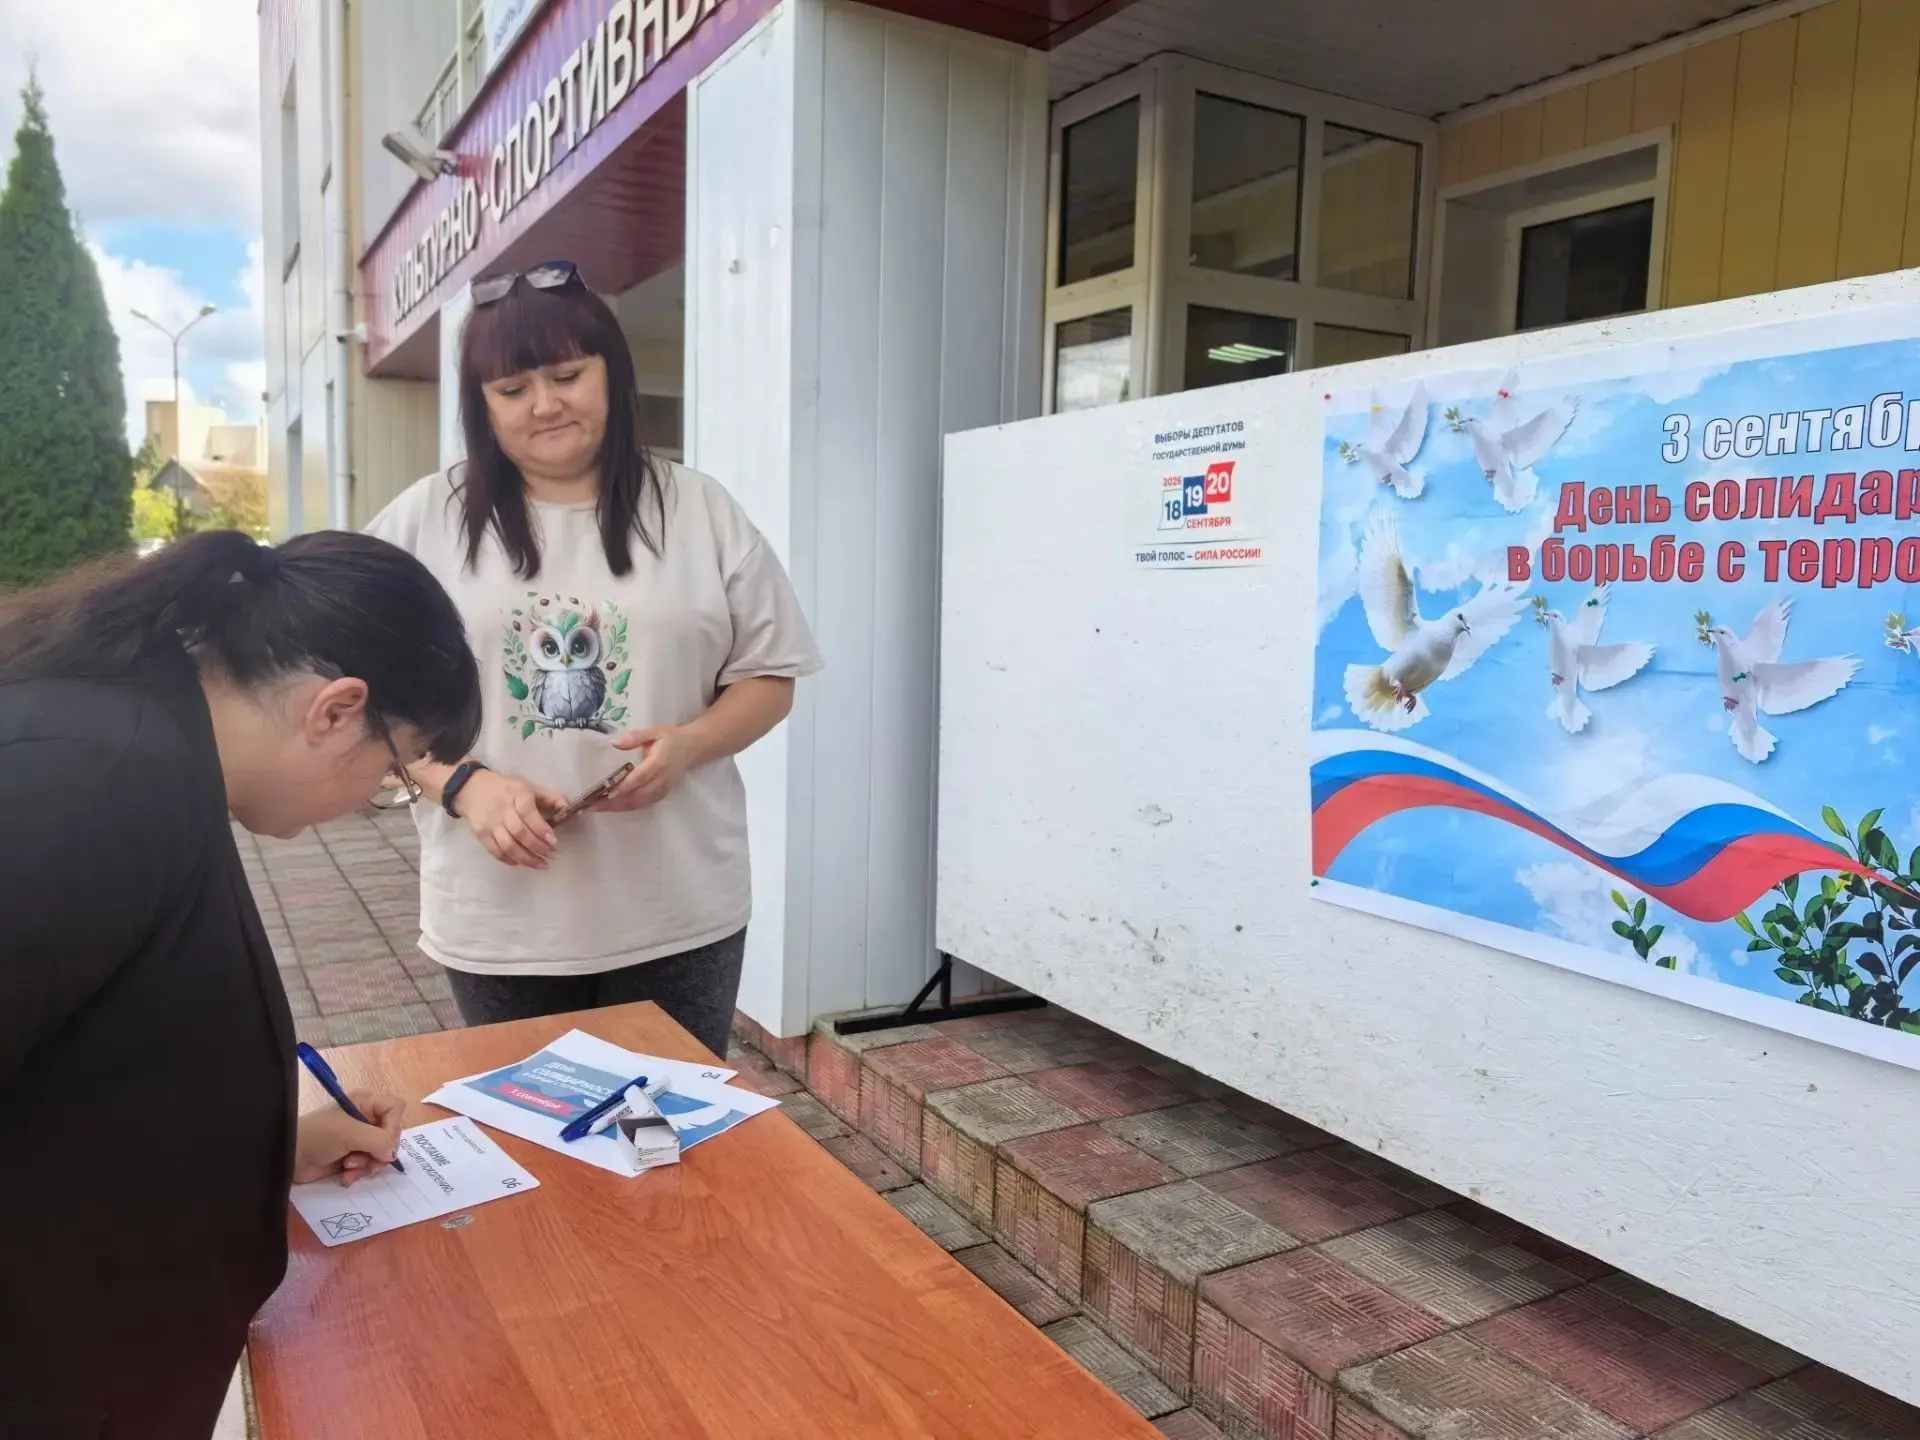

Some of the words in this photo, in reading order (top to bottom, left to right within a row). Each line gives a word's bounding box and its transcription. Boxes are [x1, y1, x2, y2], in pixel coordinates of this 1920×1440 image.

[1154, 429, 1190, 443] ВЫБОРЫ
[1192, 421, 1244, 439] ДЕПУТАТОВ
[1662, 414, 1690, 463] 3
[1152, 442, 1221, 460] ГОСУДАРСТВЕННОЙ
[1222, 440, 1246, 452] ДУМЫ
[1163, 477, 1182, 486] 2026
[1164, 500, 1181, 520] 18
[1185, 484, 1203, 507] 19
[1207, 471, 1229, 495] 20
[1553, 482, 1671, 532] День
[1684, 467, 1920, 524] солидар
[1186, 516, 1231, 528] СЕНТЯБРЯ
[1135, 550, 1156, 562] ТВОЙ
[1158, 551, 1185, 561] ГОЛОС
[1194, 551, 1218, 561] СИЛА
[1220, 549, 1261, 559] РОССИИ!
[1507, 546, 1531, 581] в
[1541, 534, 1704, 586] борьбе
[1717, 540, 1745, 581] с
[1759, 535, 1920, 588] терро
[501, 1177, 521, 1189] 06
